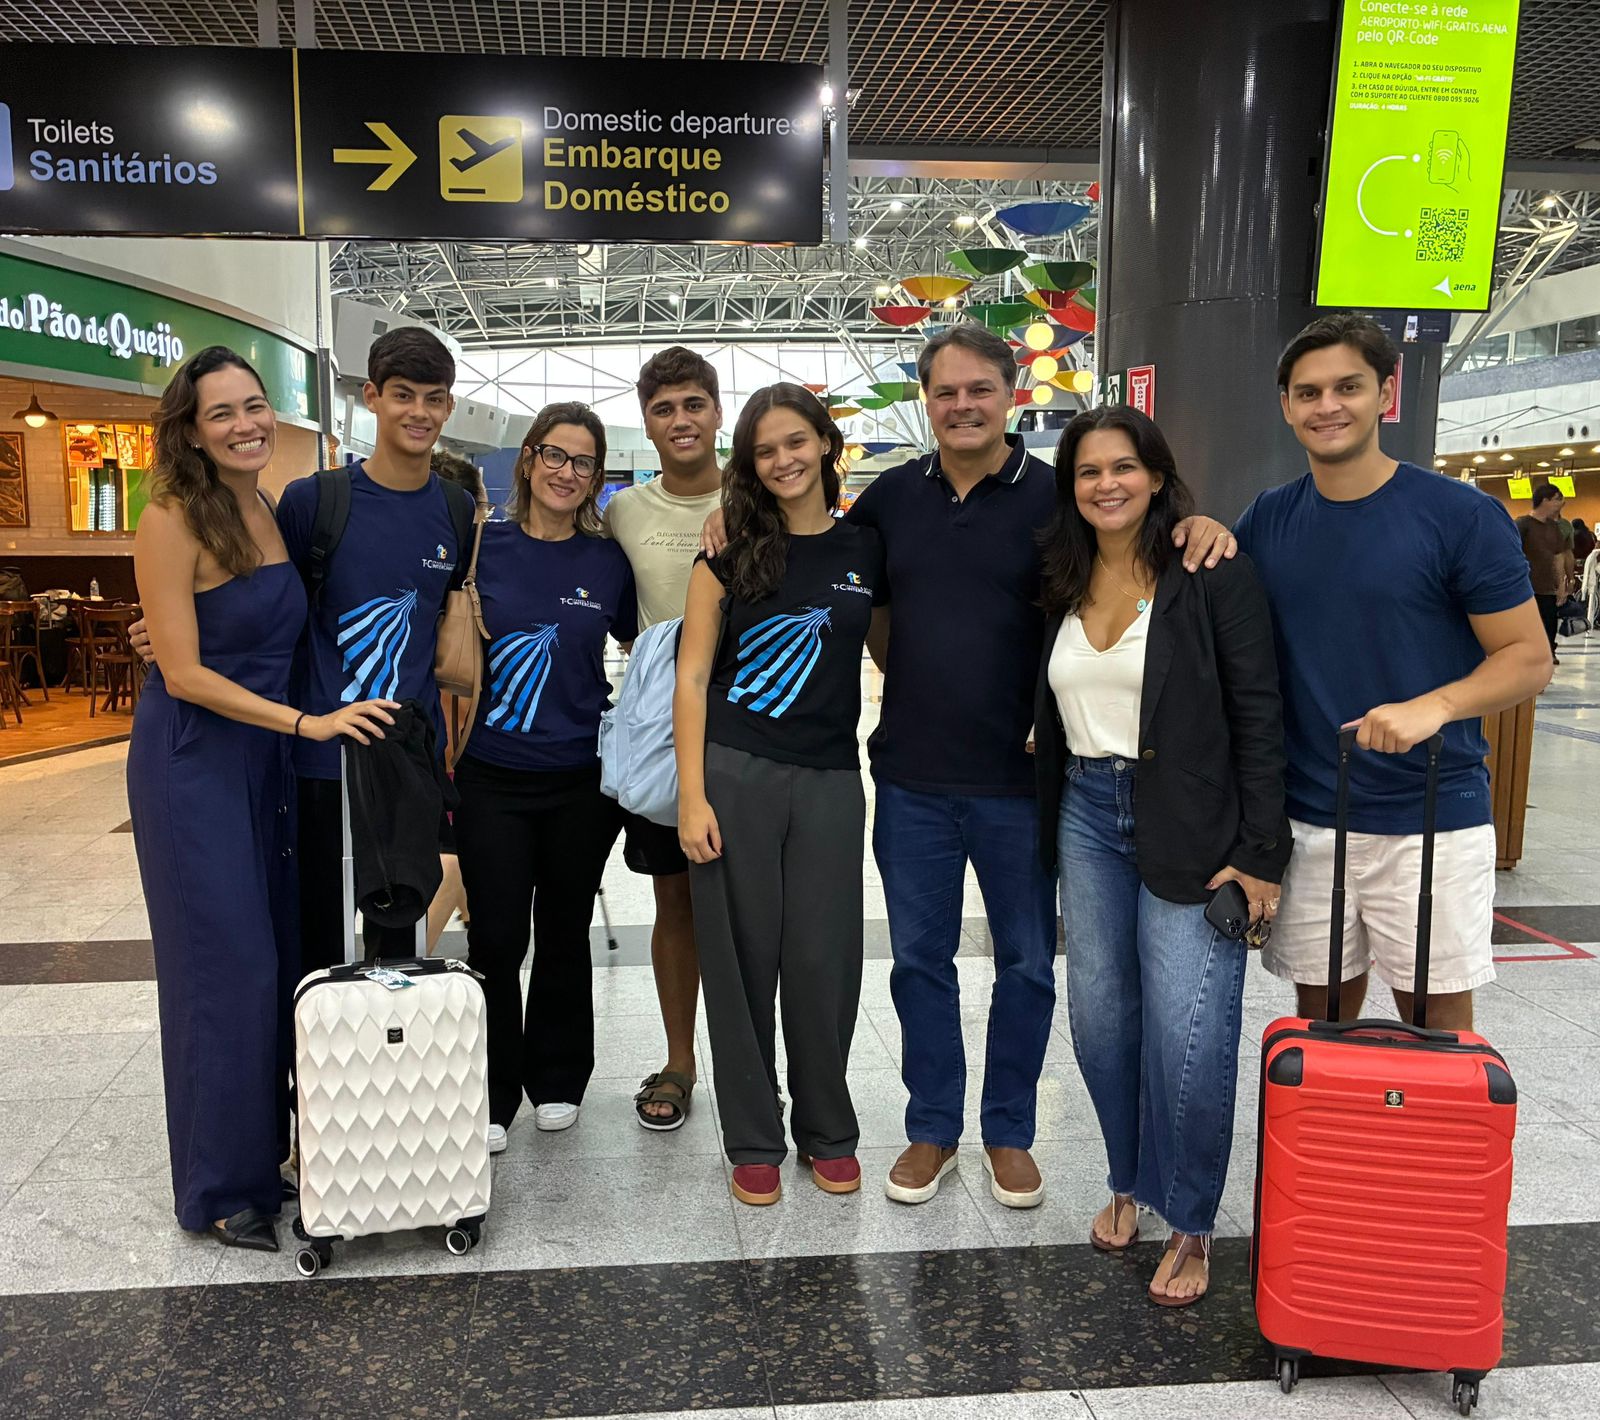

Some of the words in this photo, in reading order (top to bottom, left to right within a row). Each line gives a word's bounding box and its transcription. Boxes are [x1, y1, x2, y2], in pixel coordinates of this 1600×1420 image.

[1360, 0, 1428, 15] Conecte-se
[1431, 3, 1438, 16] à
[1442, 5, 1469, 18] rede
[1357, 29, 1384, 44] pelo
[1386, 30, 1439, 45] QR-Code
[1352, 71, 1358, 79] 2.
[1359, 72, 1380, 80] CLIQUE
[1391, 73, 1412, 81] OPÇÃO
[1385, 62, 1421, 70] NAVEGADOR
[1445, 65, 1482, 74] DISPOSITIVO
[27, 118, 115, 145] Toilets
[543, 106, 663, 133] Domestic
[670, 109, 807, 140] departures
[29, 150, 218, 185] Sanitários
[543, 137, 722, 177] Embarque
[543, 180, 730, 213] Doméstico
[1453, 283, 1477, 291] aena
[28, 293, 82, 341] Pão
[85, 316, 109, 346] de
[110, 312, 184, 368] Queijo
